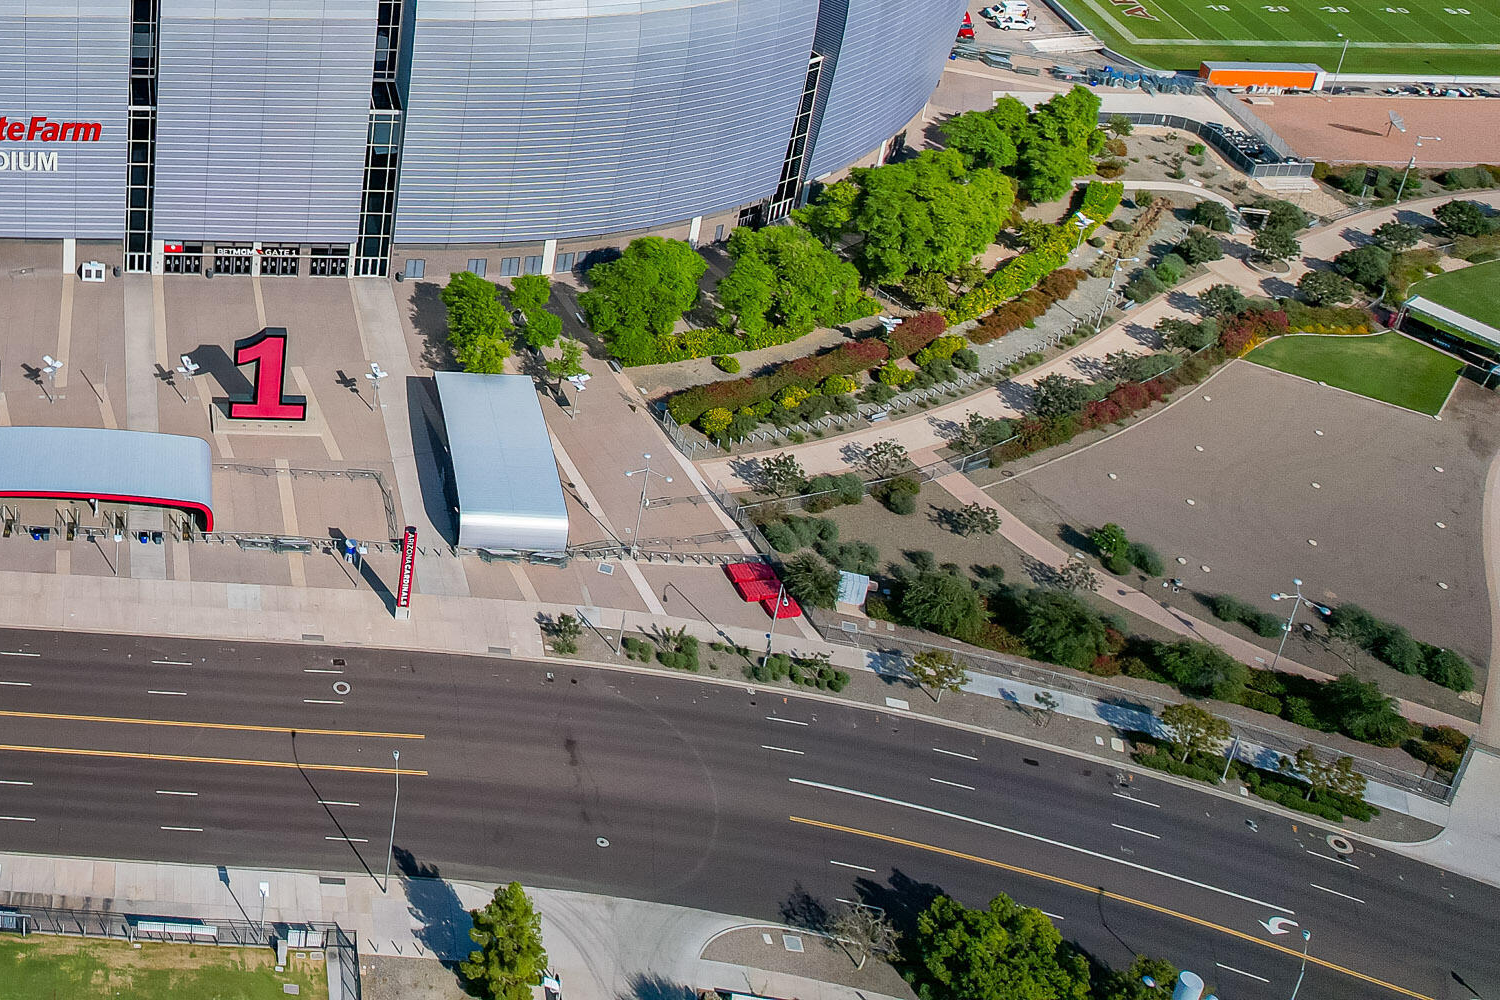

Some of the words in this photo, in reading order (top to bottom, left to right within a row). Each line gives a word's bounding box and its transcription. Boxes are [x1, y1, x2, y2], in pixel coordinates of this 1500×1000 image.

[264, 248, 290, 256] GATE
[227, 327, 307, 421] 1
[405, 533, 414, 564] ARIZONA
[400, 564, 412, 606] CARDINALS
